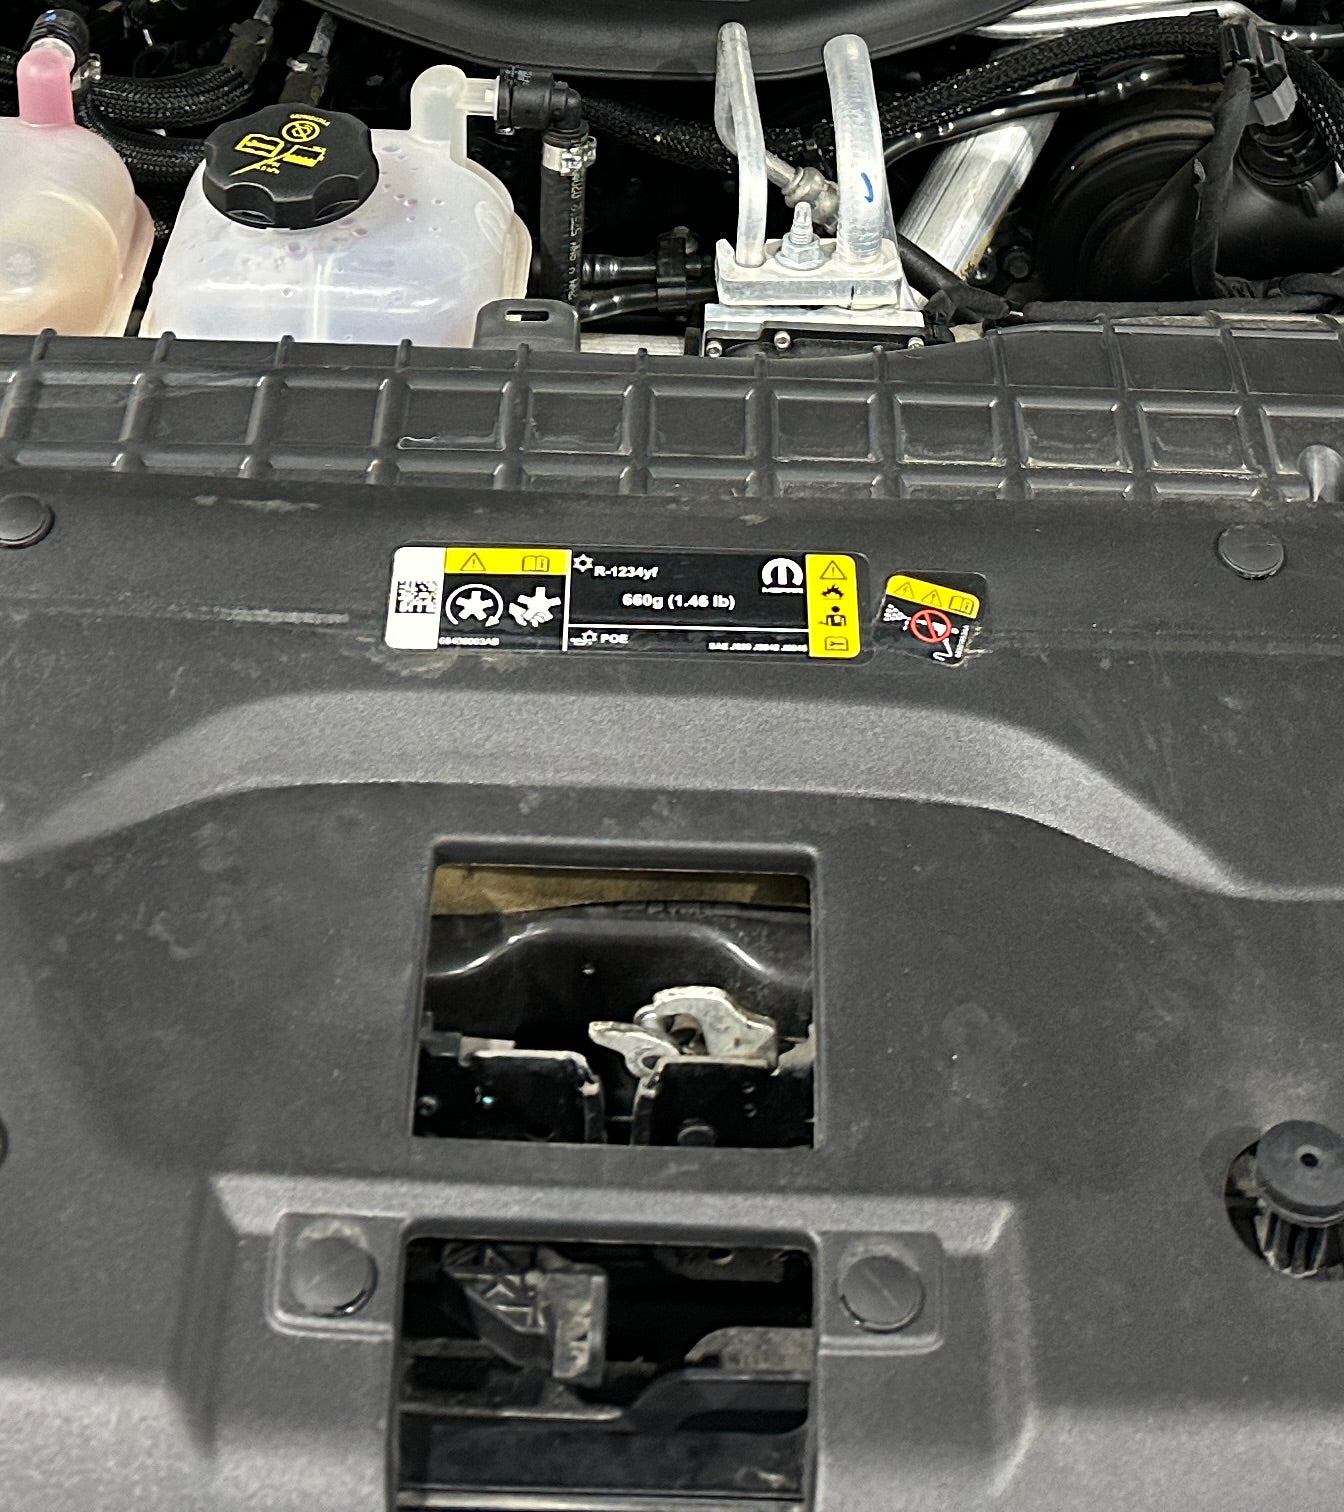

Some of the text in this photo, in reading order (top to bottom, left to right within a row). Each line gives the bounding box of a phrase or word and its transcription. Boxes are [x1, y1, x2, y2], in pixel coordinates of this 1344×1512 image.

[593, 565, 659, 581] R-1234yf
[621, 593, 736, 611] 660g (1.46 lb)
[599, 633, 629, 644] POE
